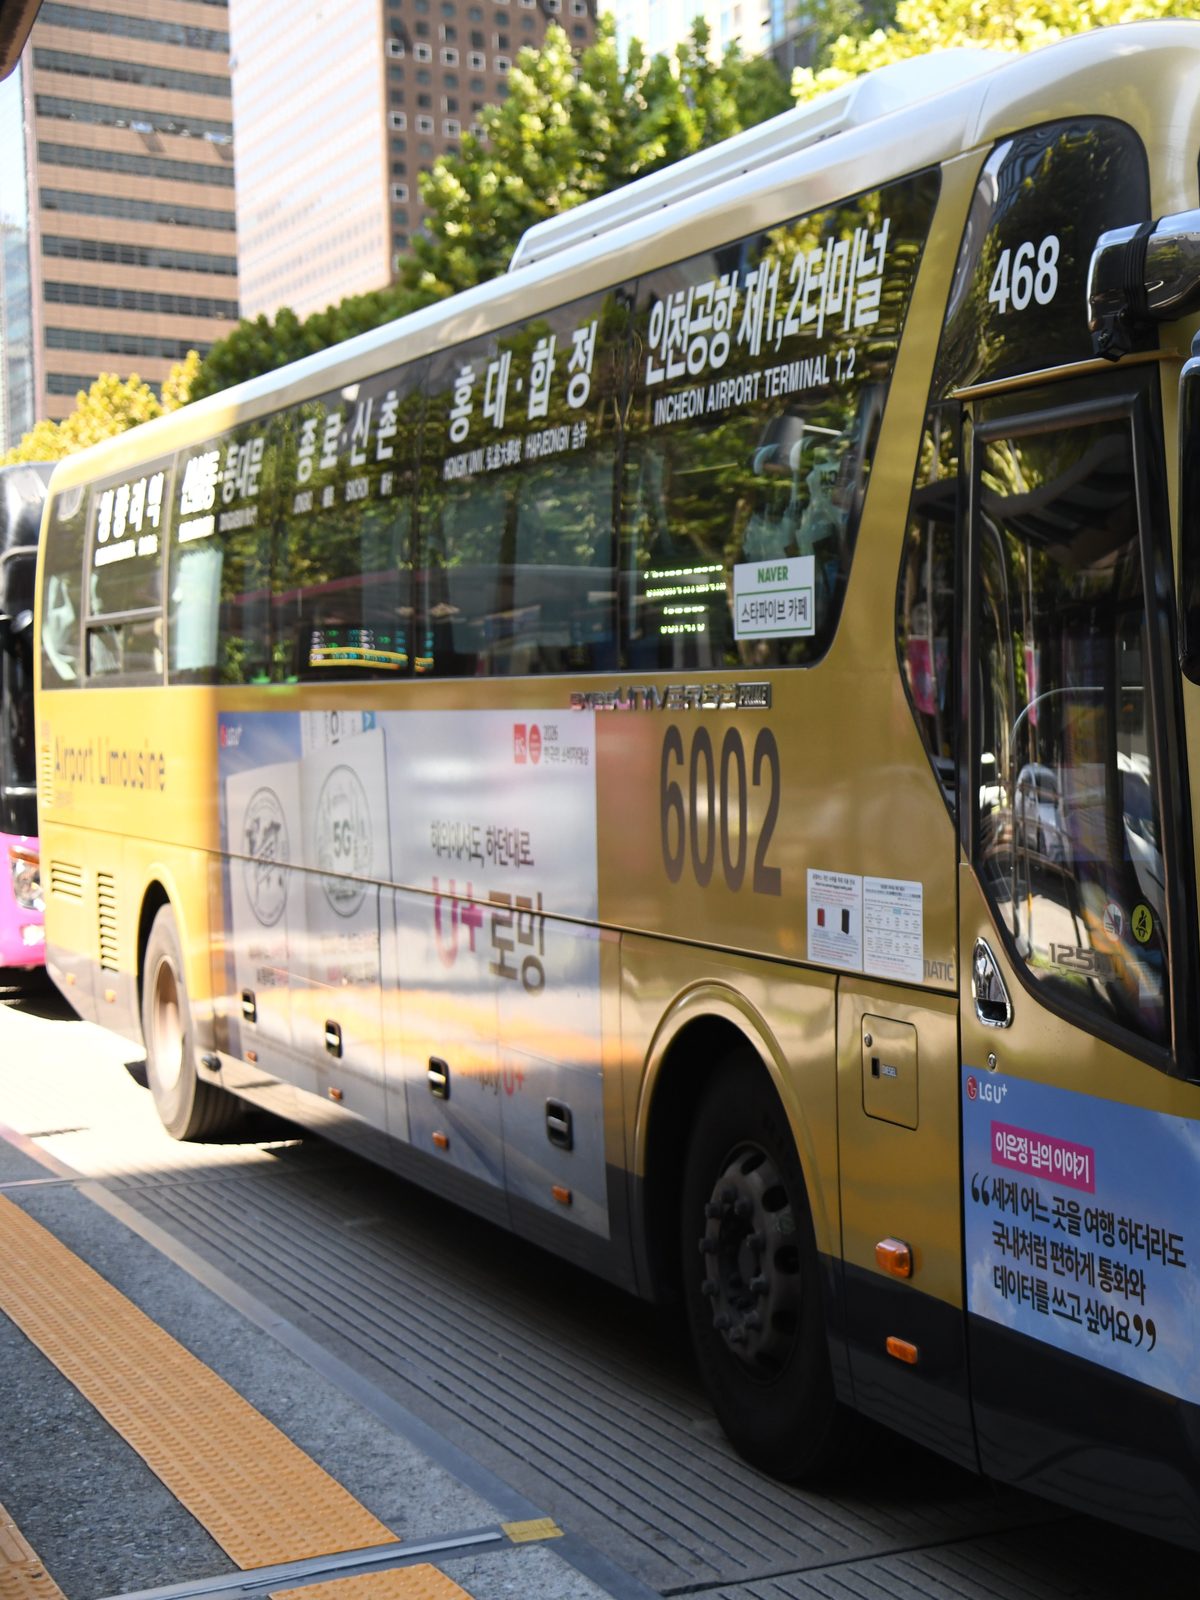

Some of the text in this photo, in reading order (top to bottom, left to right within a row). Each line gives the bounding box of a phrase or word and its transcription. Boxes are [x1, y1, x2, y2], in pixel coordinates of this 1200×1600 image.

[988, 234, 1060, 315] 468
[645, 270, 738, 386] 인천공항
[654, 347, 856, 426] INCHEON AIRPORT TERMINAL 1,2
[741, 595, 808, 625] 스타파이브 카페
[757, 565, 789, 584] NAVER
[660, 724, 782, 897] 6002
[995, 1131, 1090, 1183] 이은정 님의 이야기
[992, 1220, 1146, 1306] 국내처럼 편하게 통화와
[1020, 1187, 1050, 1224] 어느
[1051, 1197, 1082, 1237] 곳을
[1084, 1207, 1115, 1248] 여행
[1117, 1216, 1187, 1269] 하더라도
[993, 1265, 1050, 1316] 데이터를
[1052, 1287, 1083, 1325] 쓰고
